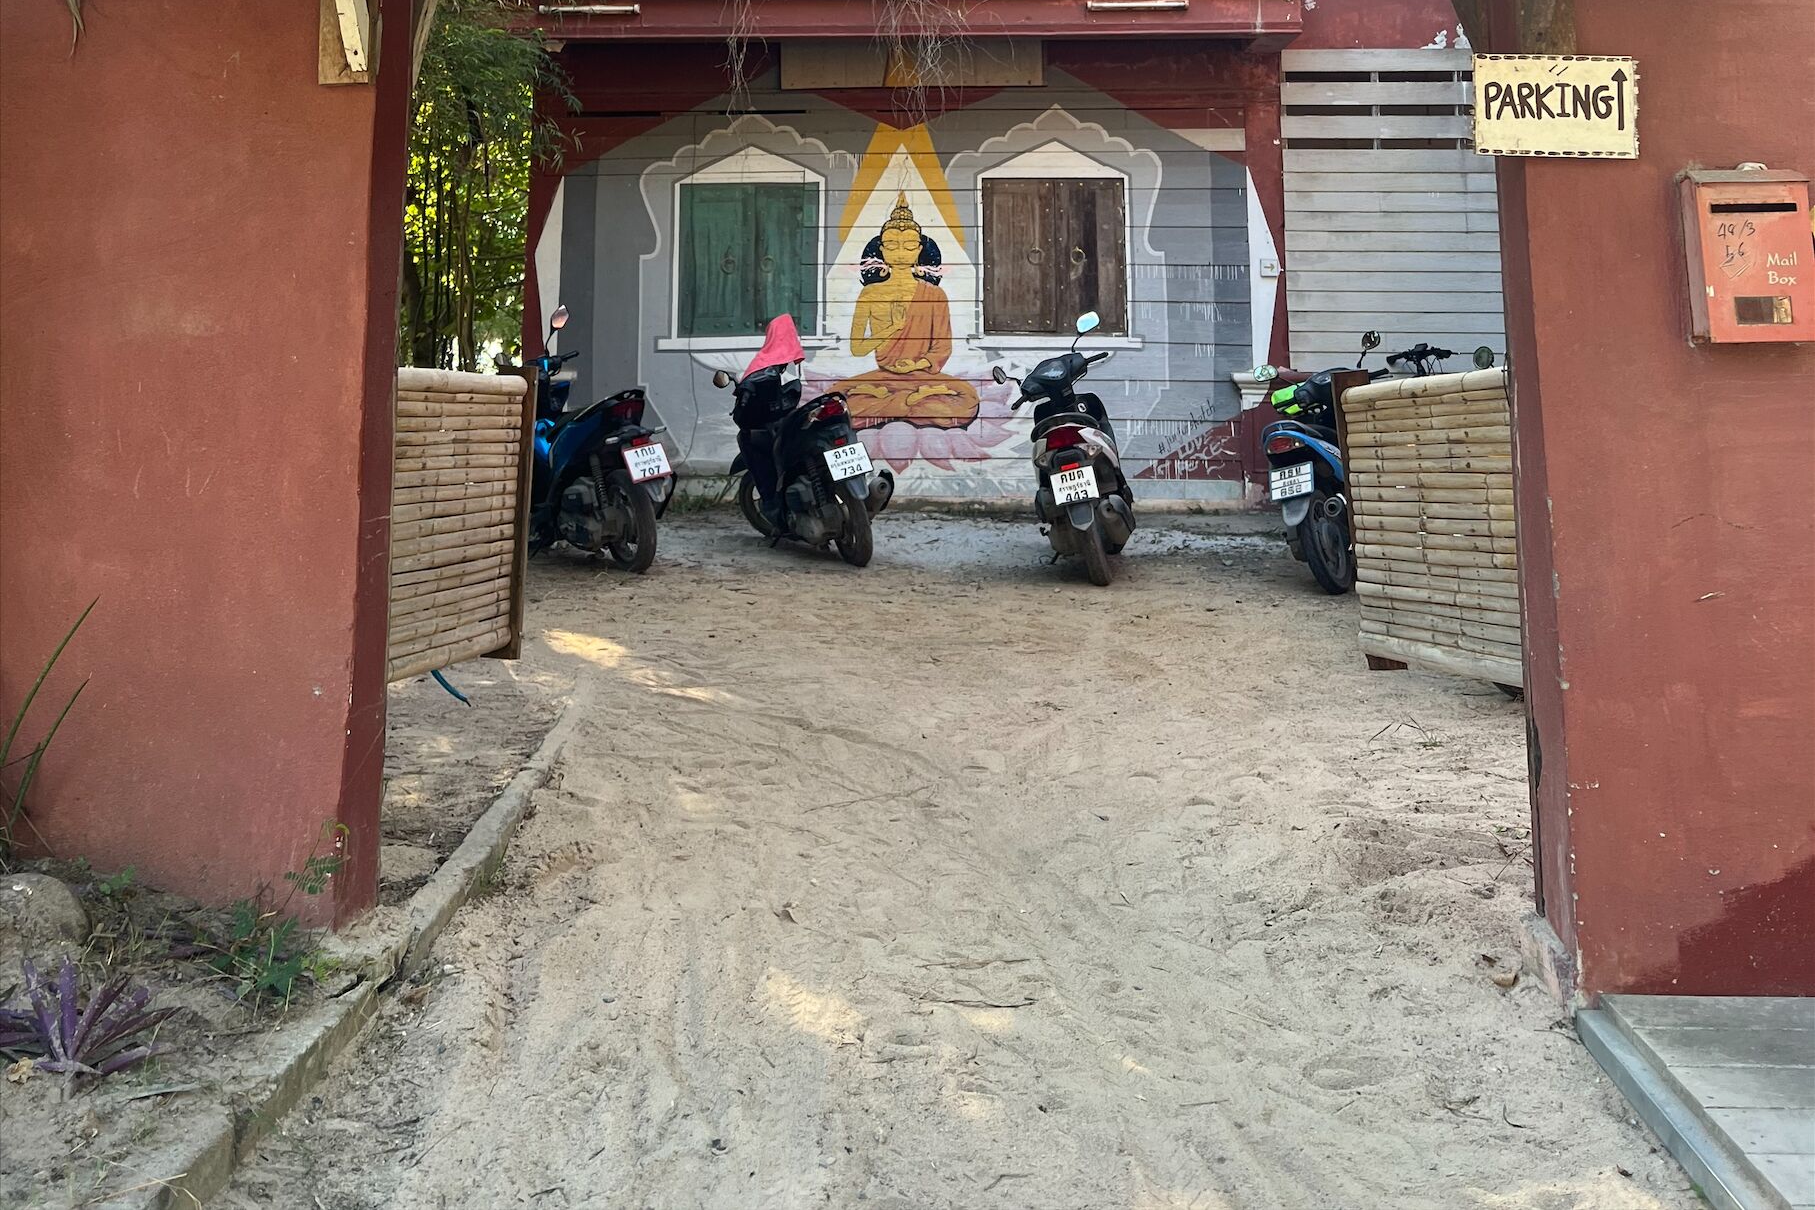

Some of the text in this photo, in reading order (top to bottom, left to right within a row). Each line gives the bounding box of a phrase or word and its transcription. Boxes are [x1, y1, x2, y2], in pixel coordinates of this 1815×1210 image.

[1484, 81, 1614, 121] PARKING
[1766, 251, 1798, 268] Mail
[1767, 270, 1797, 285] Box
[640, 465, 661, 477] 707
[840, 464, 863, 476] 734
[1066, 489, 1089, 502] 443
